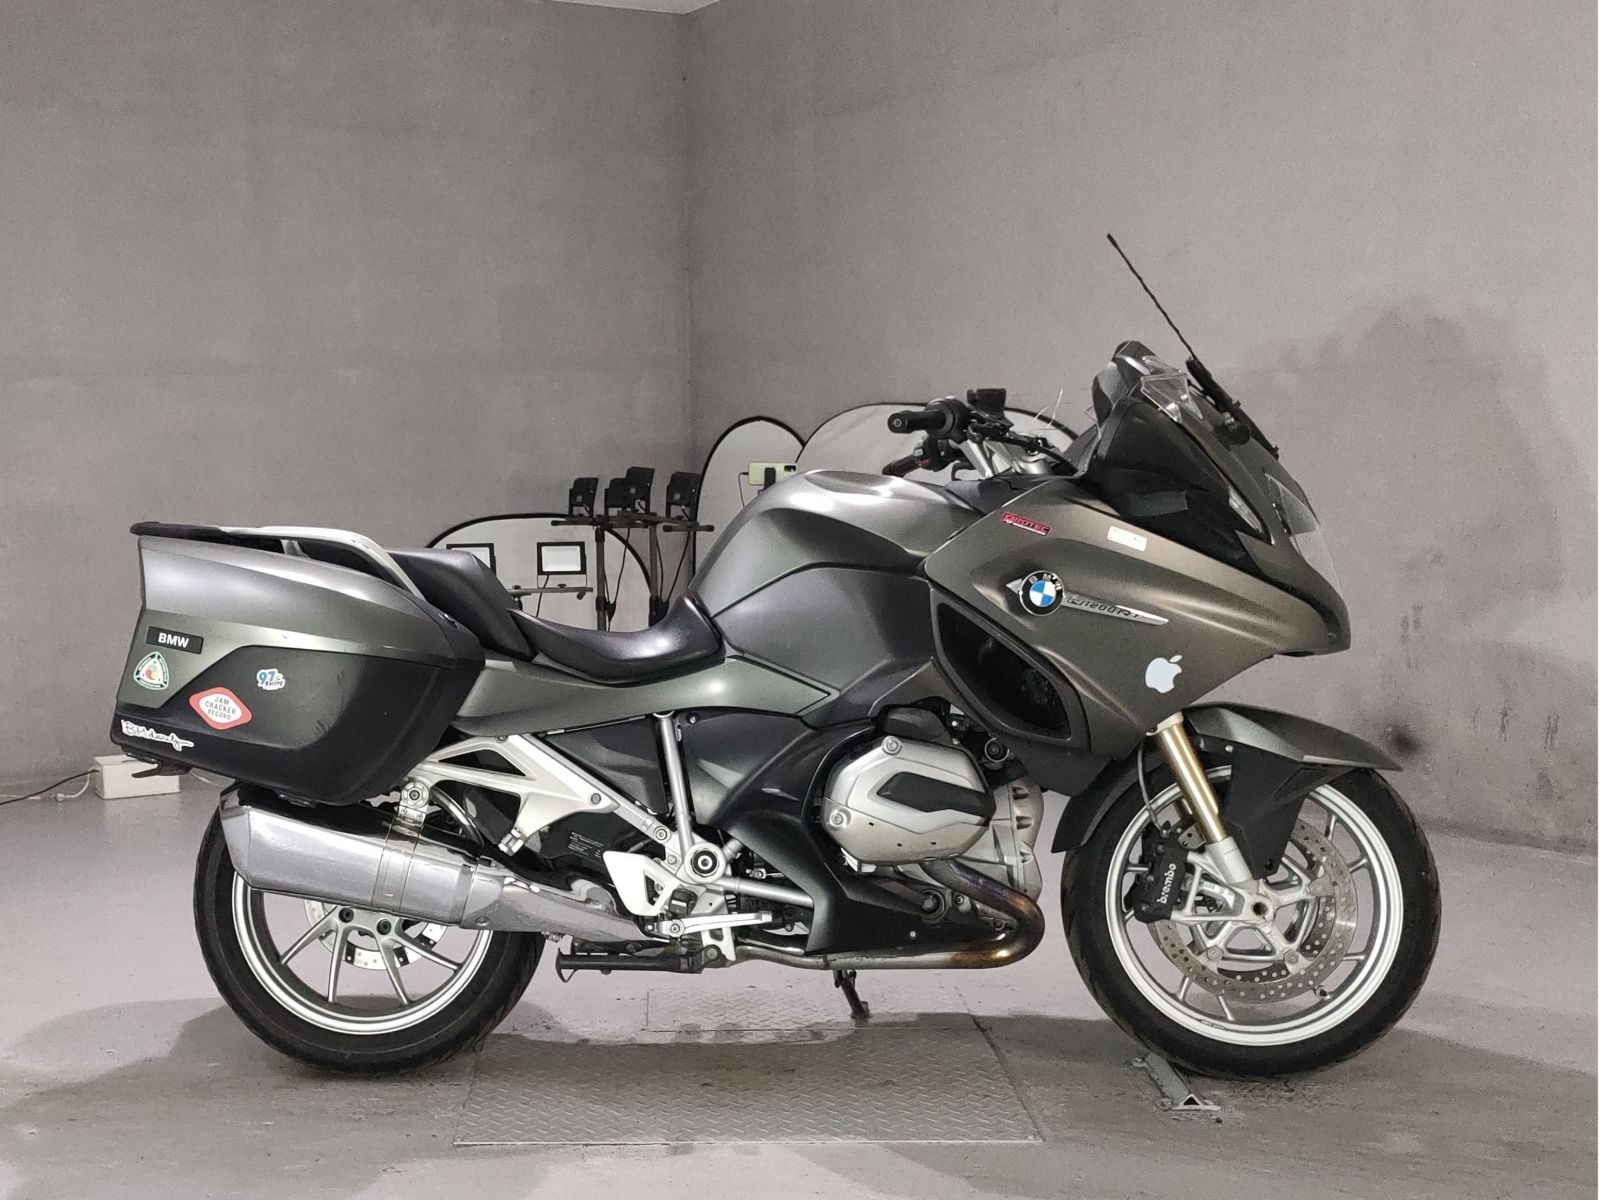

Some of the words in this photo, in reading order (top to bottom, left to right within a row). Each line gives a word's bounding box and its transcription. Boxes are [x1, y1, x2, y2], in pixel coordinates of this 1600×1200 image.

[1028, 573, 1062, 591] BMW
[158, 632, 189, 648] BMW
[258, 671, 276, 685] 97
[205, 700, 236, 715] CRACKER
[215, 696, 230, 705] JAM
[207, 709, 232, 721] RECORD
[1156, 863, 1176, 904] brembo
